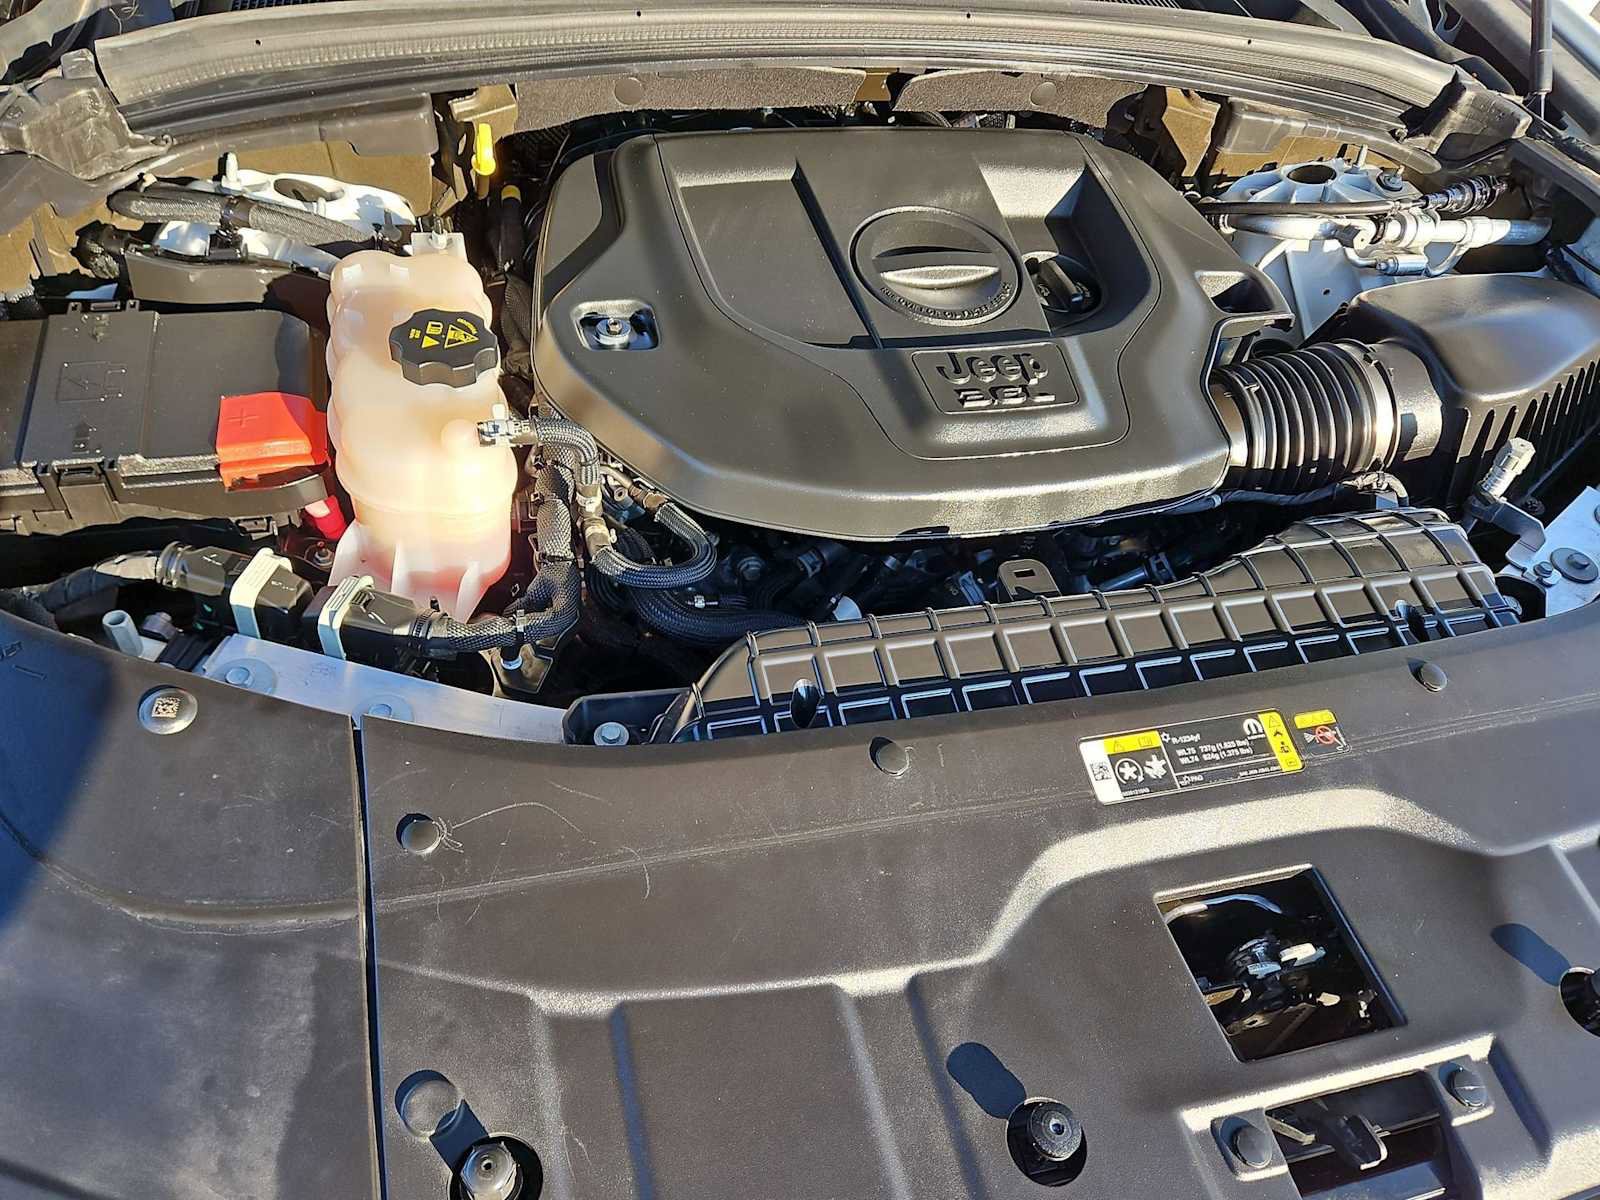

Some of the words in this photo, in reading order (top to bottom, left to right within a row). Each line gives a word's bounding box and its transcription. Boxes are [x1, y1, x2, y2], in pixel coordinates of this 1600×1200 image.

[936, 352, 1048, 386] Jeep
[953, 385, 1056, 408] 3.6L
[1199, 744, 1217, 753] 737g
